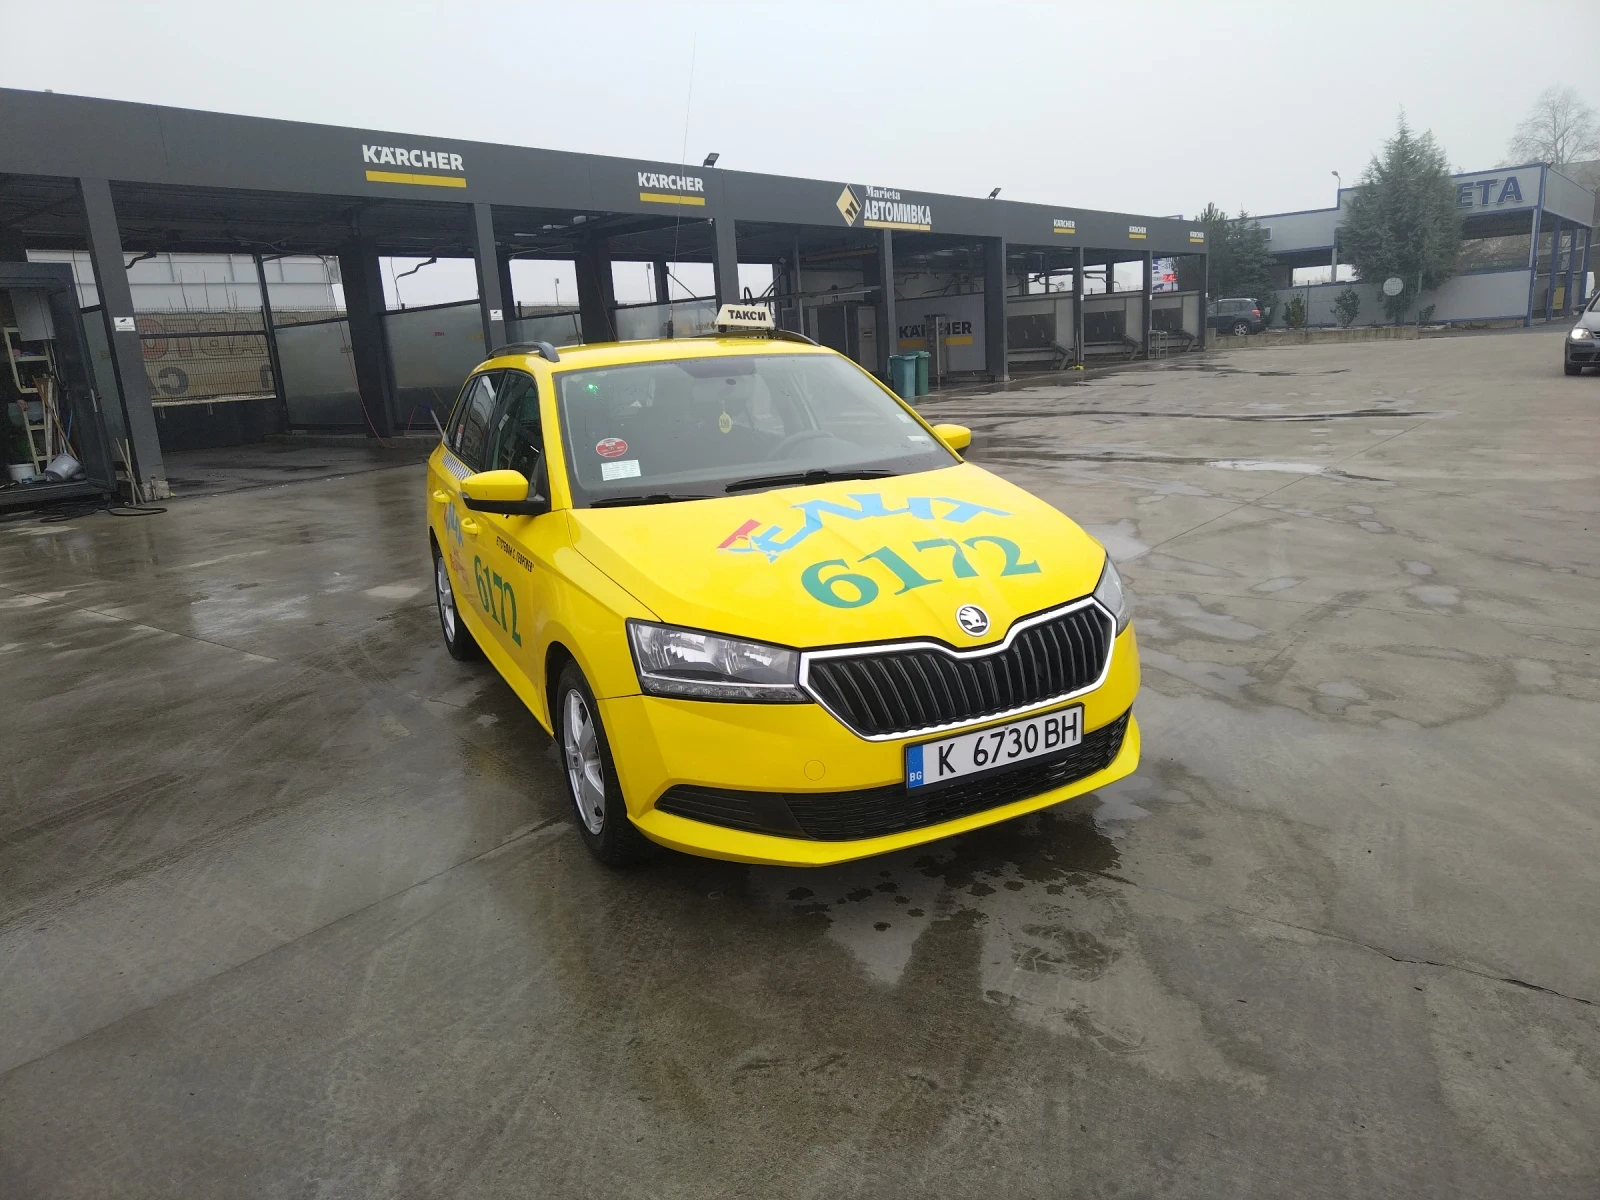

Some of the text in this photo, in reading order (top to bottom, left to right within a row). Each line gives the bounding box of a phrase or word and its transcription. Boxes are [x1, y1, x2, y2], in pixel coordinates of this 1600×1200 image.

[361, 144, 465, 171] KÄRCHER
[637, 171, 705, 192] KÄRCHER
[865, 185, 901, 200] Marieta
[864, 199, 932, 225] АВТОМИВКА
[1053, 218, 1076, 228] KÄRCHER
[1128, 225, 1147, 234] KÄRCHER
[727, 309, 767, 321] ТАКСИ
[801, 535, 1042, 609] 6172
[474, 554, 522, 648] 6172
[938, 712, 1077, 776] K 6730 BH
[909, 770, 922, 782] BG
